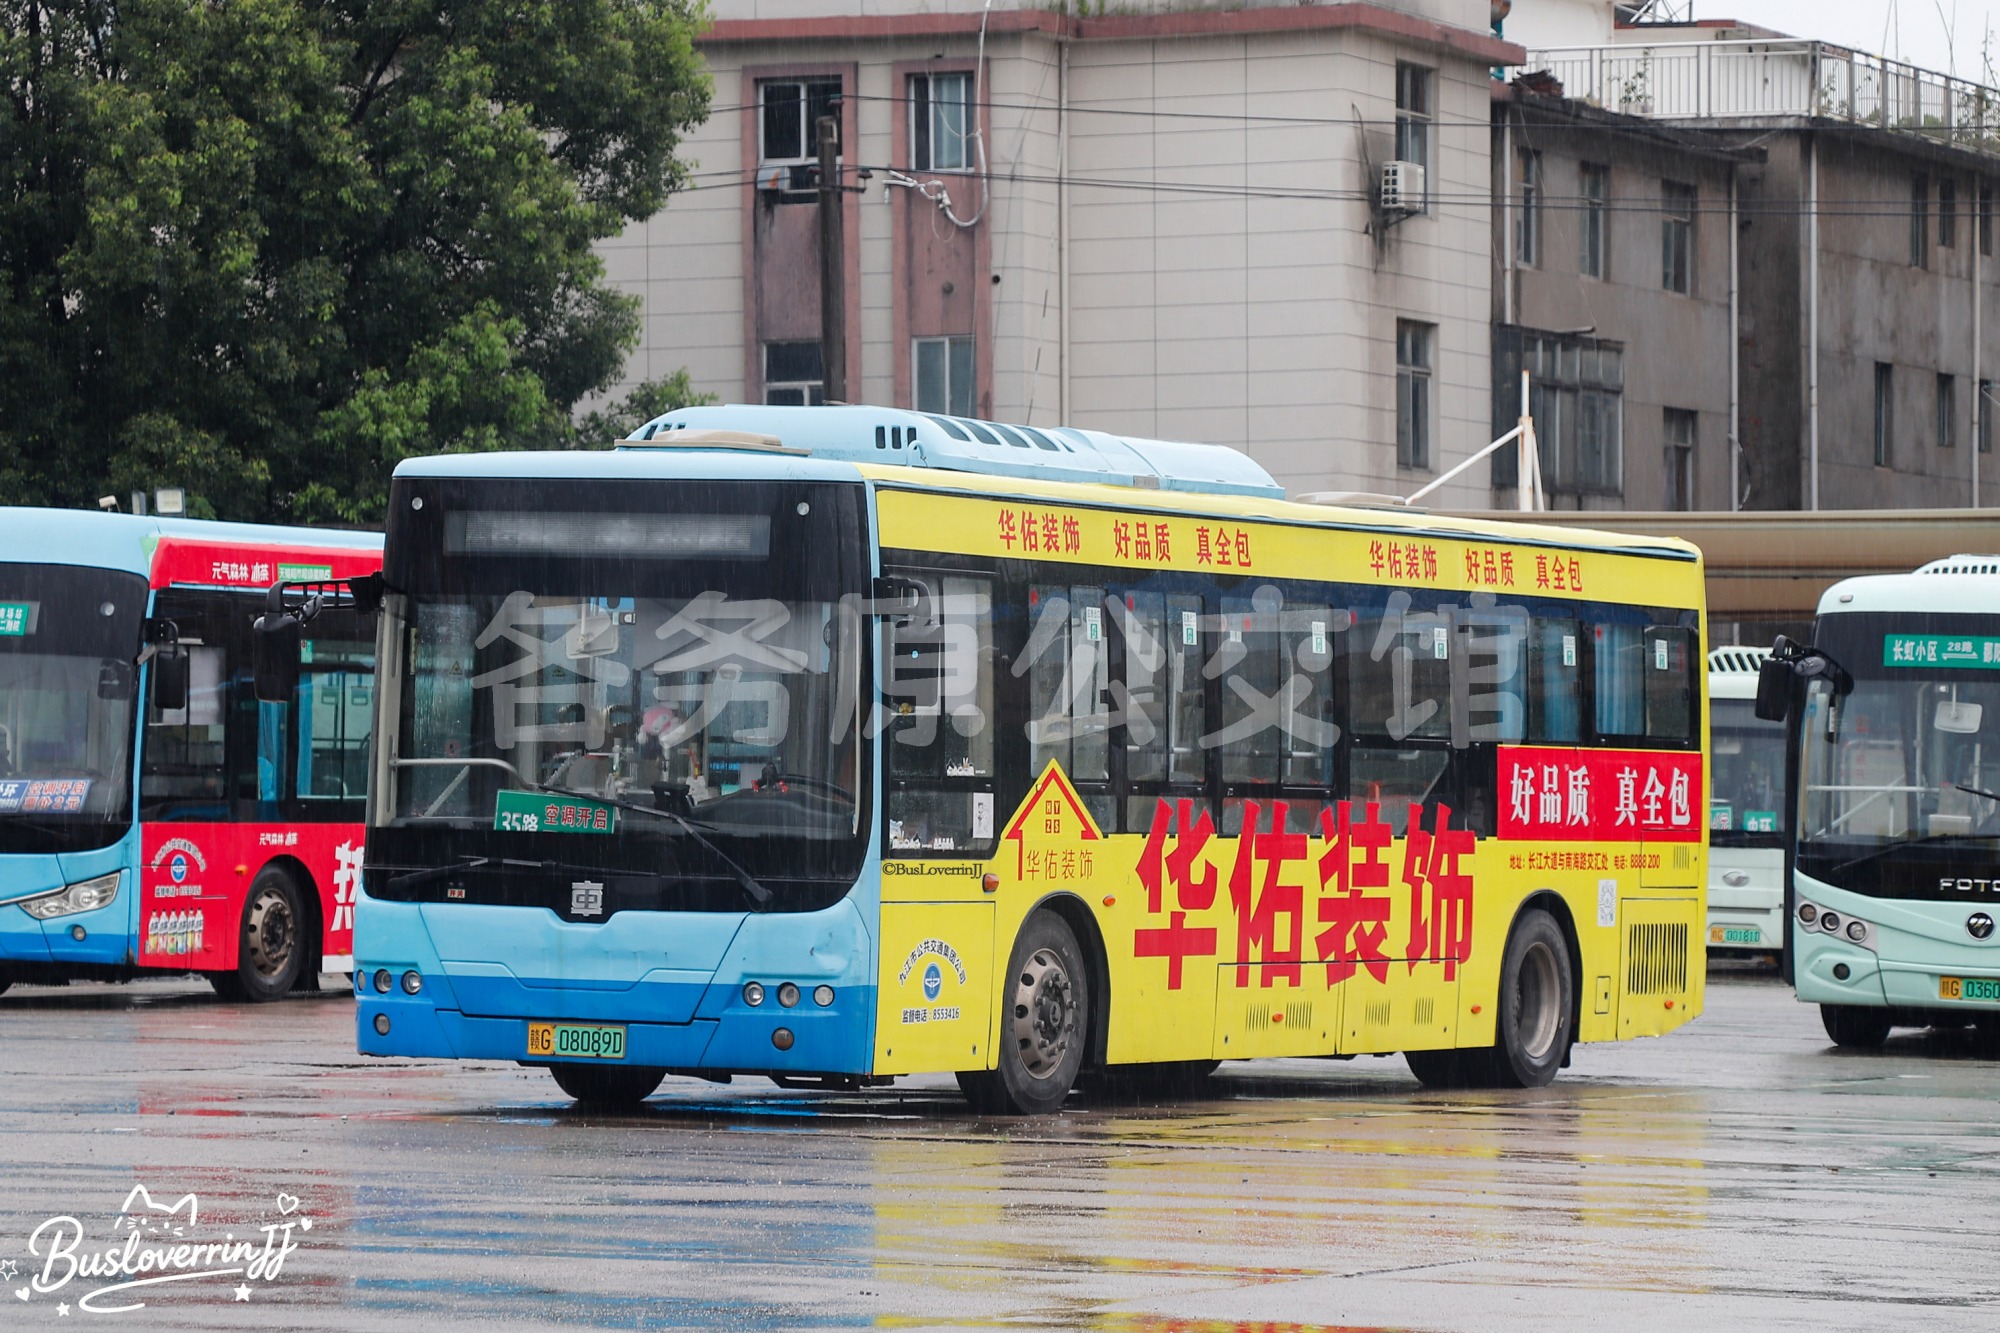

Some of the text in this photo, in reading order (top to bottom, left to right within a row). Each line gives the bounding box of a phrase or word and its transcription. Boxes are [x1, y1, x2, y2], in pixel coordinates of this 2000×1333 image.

[998, 509, 1253, 568] 华佑装饰 好品质 真全包
[212, 561, 249, 580] 元气森林
[1369, 539, 1583, 592] 华佑装饰 好品质 真全包
[1893, 639, 1938, 662] 长虹小区
[1946, 641, 1974, 653] 28路
[544, 804, 609, 830] 空调开启
[1510, 762, 1691, 827] 好品质 真全包
[1026, 849, 1093, 881] 华佑装饰
[1134, 798, 1475, 991] 华佑装饰
[898, 938, 967, 986] 九江市公共交通集团公司
